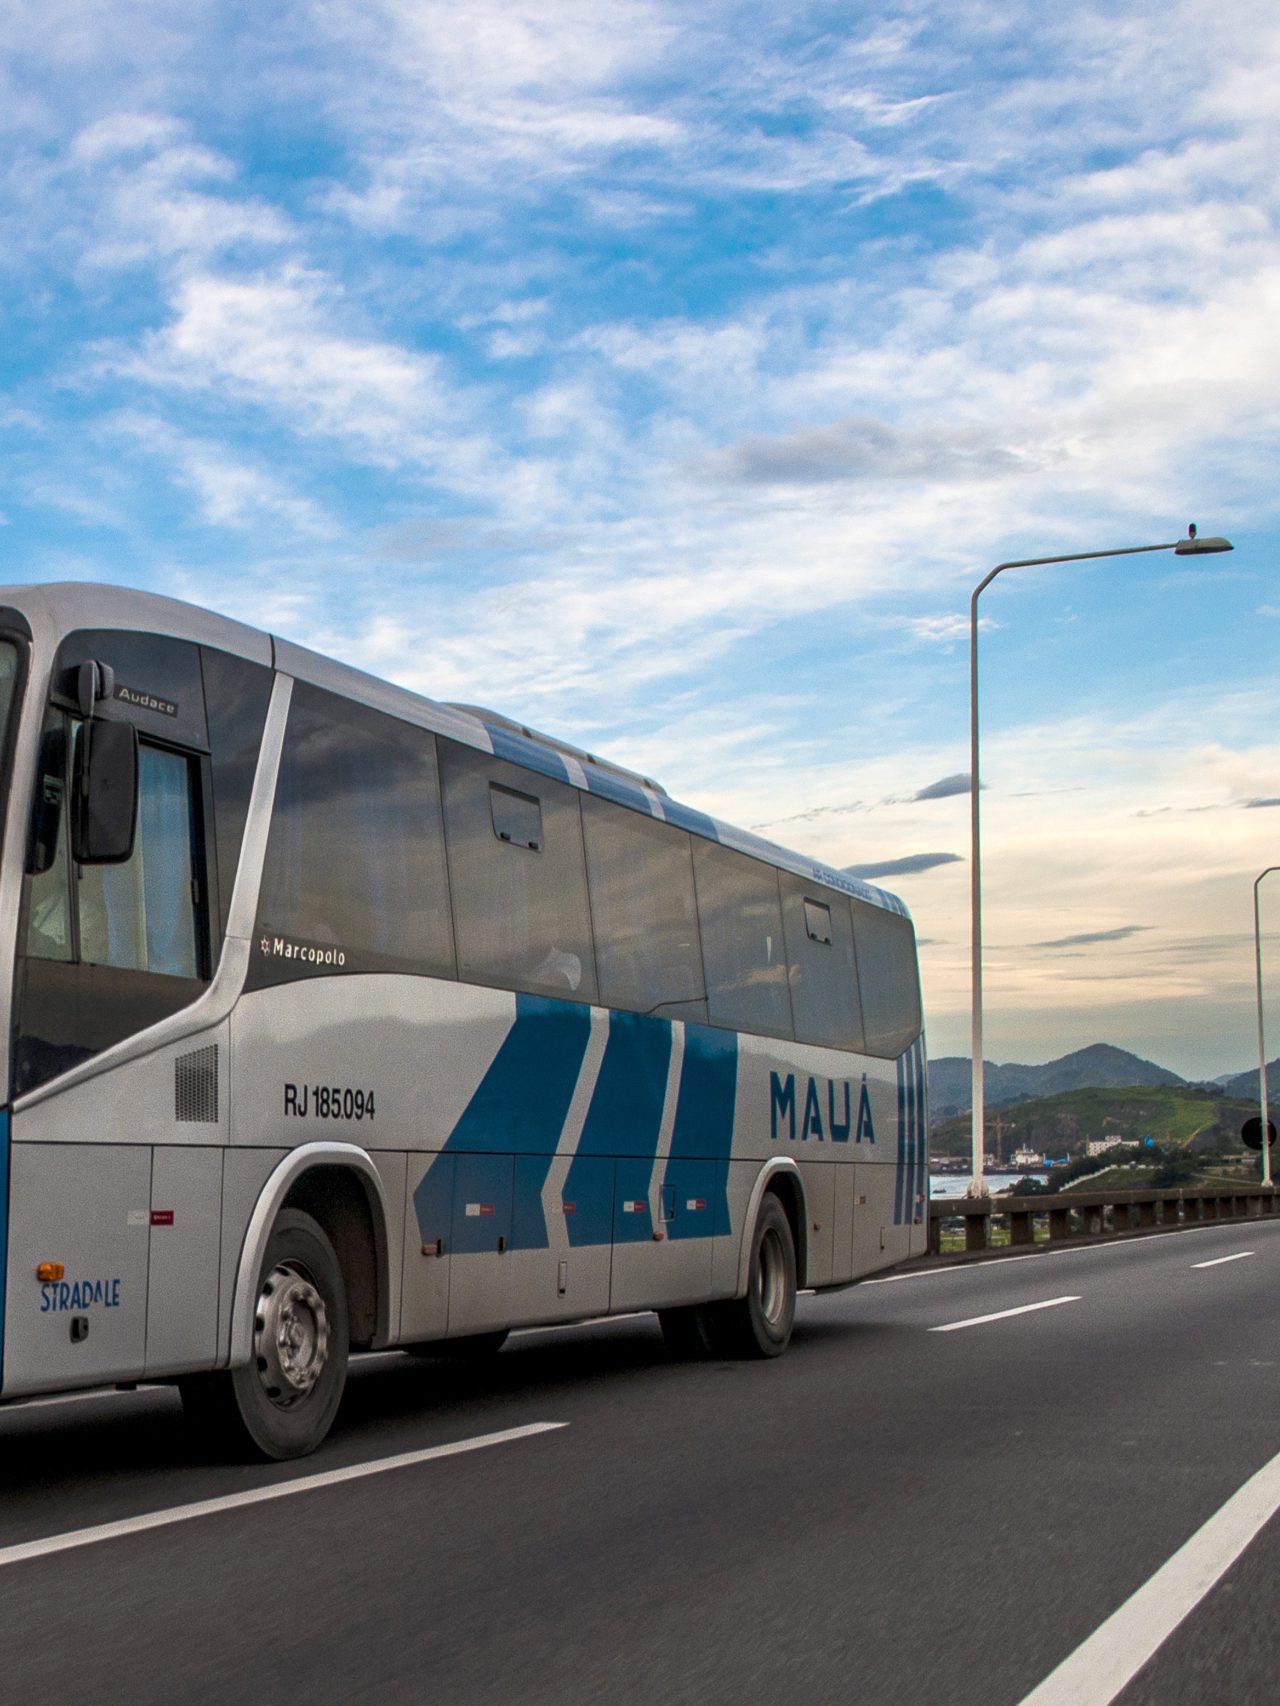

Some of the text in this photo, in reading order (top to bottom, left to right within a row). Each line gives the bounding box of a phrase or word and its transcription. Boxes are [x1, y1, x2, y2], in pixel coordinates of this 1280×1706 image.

[119, 688, 175, 714] Audace
[273, 938, 345, 966] Marcopolo
[284, 1083, 376, 1121] RJ 185.094
[769, 1071, 876, 1145] MAUÁ
[40, 1279, 121, 1313] STRADALE
